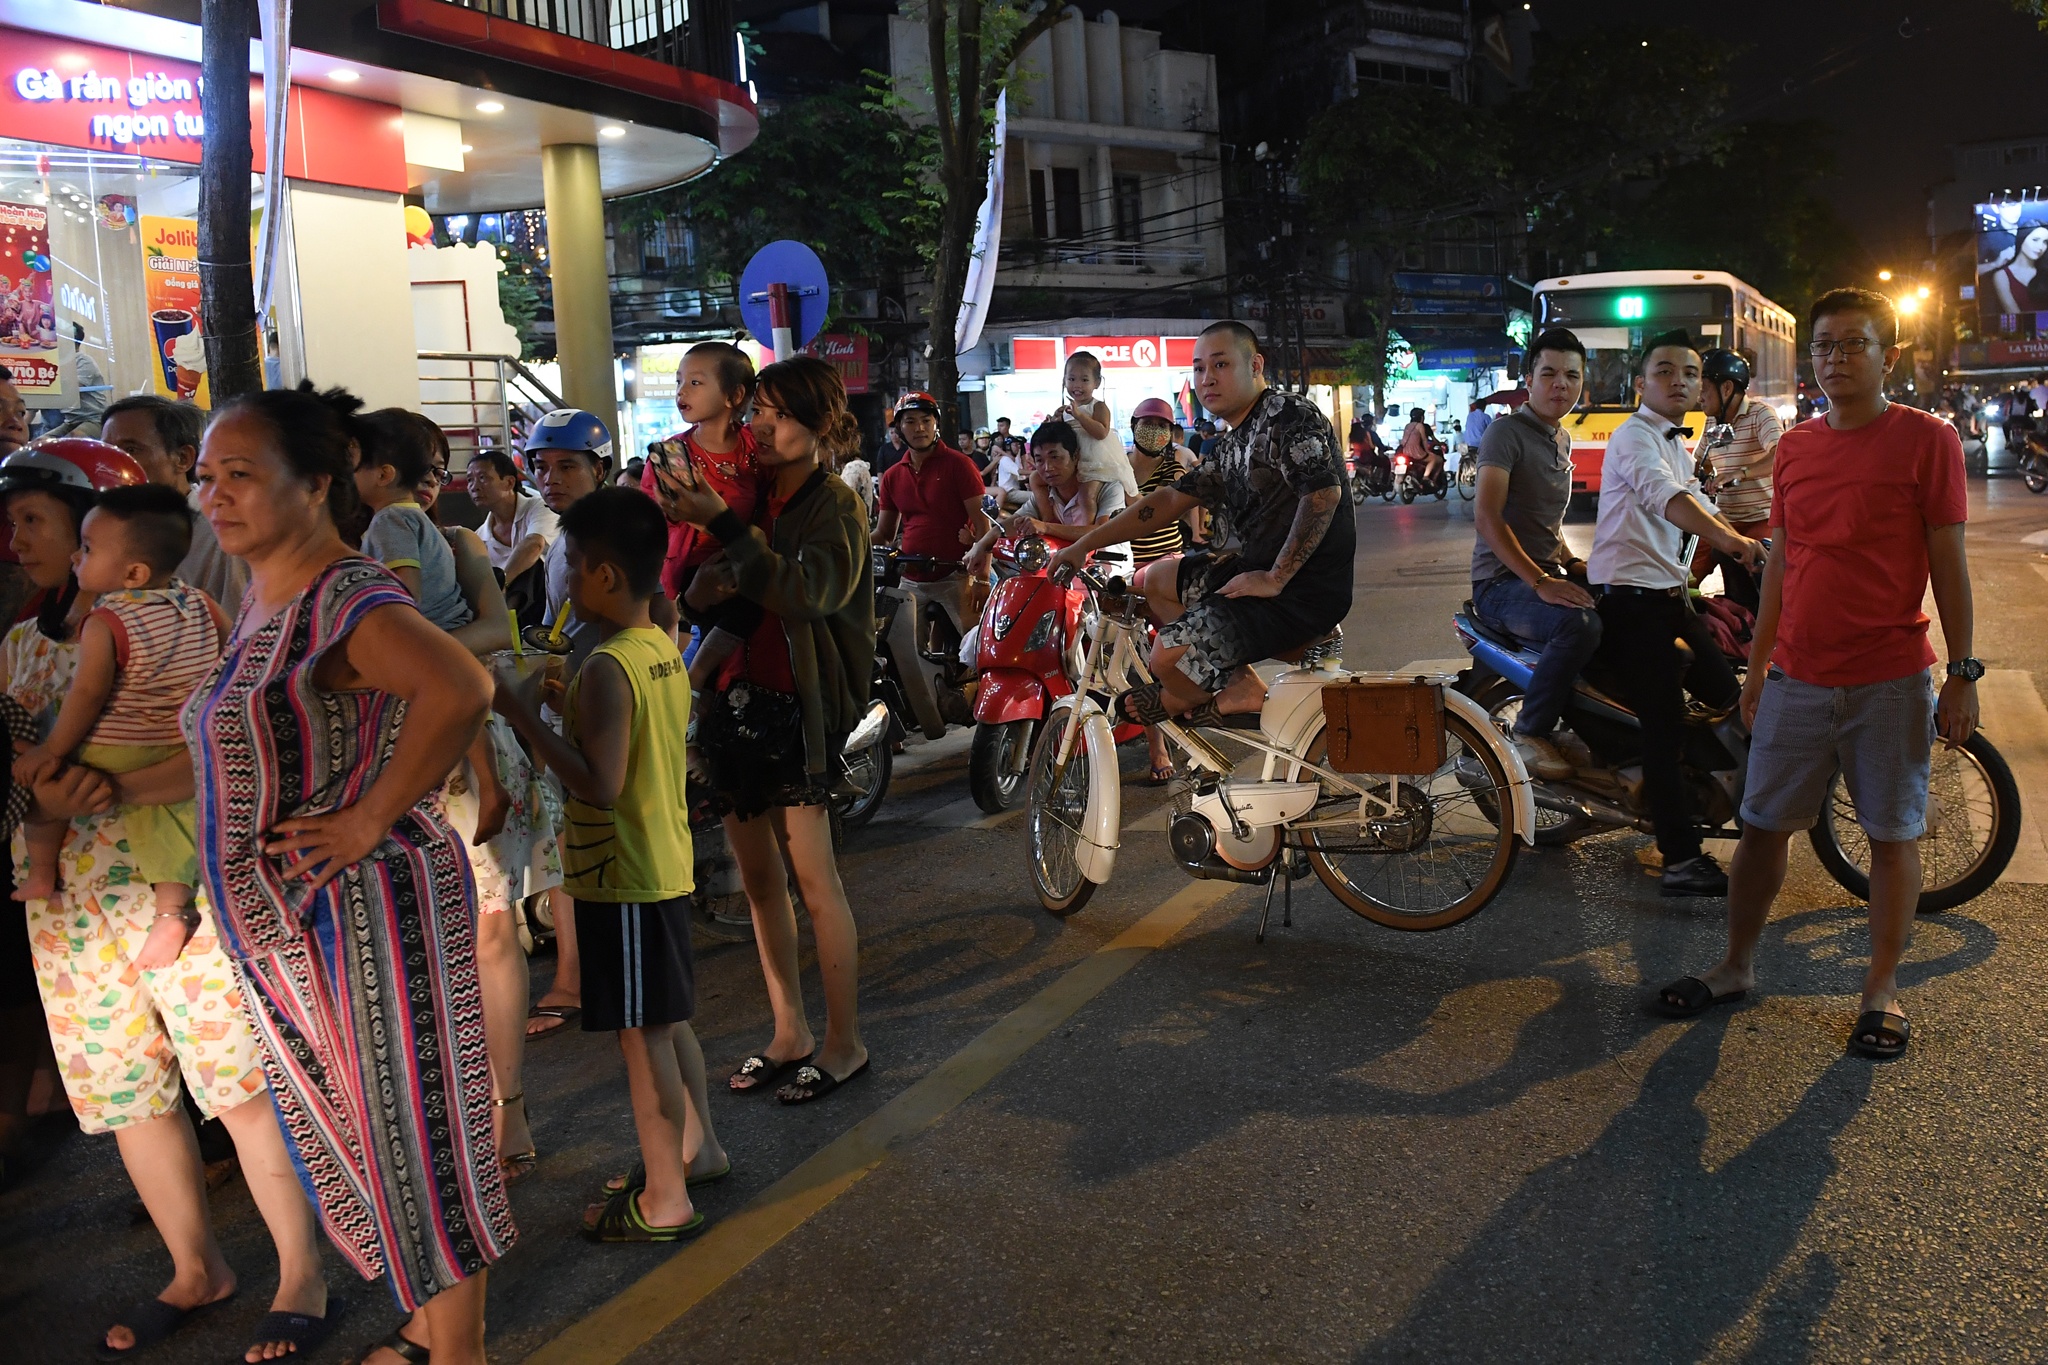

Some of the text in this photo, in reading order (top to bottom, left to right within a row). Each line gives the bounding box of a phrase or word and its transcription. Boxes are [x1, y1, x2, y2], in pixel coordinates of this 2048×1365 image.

[16, 67, 64, 100] Gà
[70, 69, 122, 100] rán
[127, 71, 193, 107] giòn
[92, 109, 204, 144] ngon tu
[155, 227, 199, 248] Jollib
[1618, 296, 1644, 319] 01
[38, 367, 56, 379] Bé
